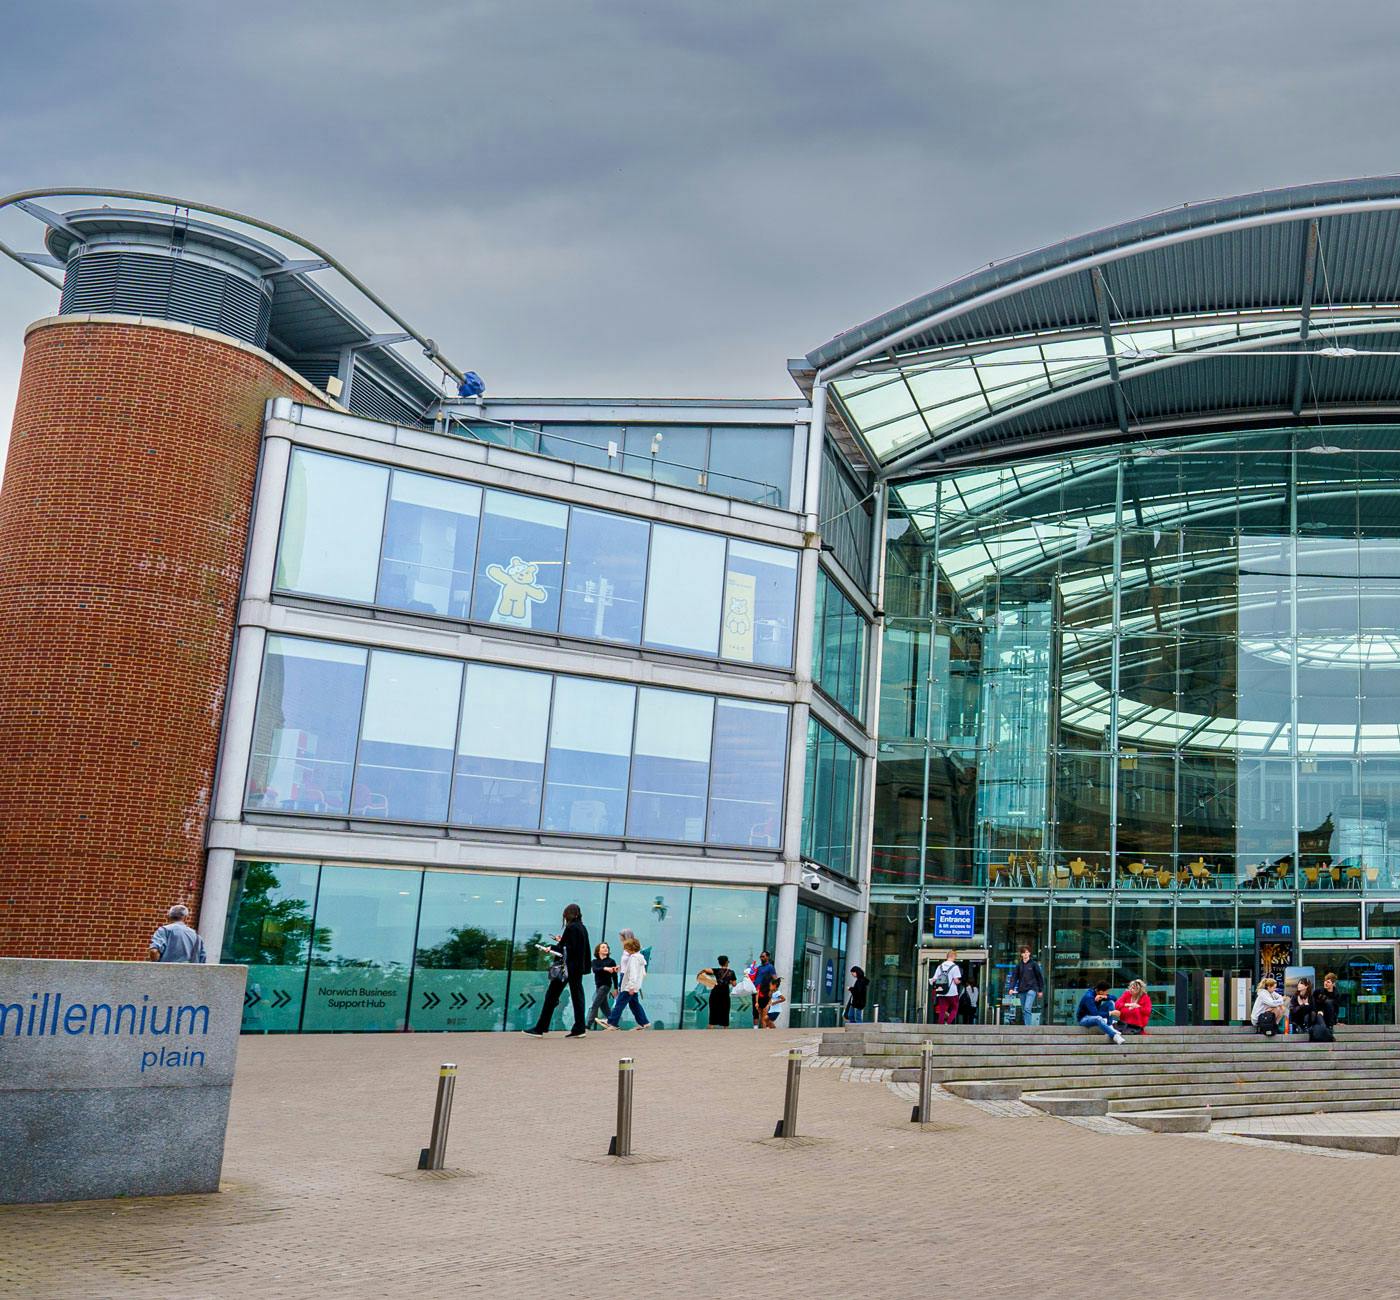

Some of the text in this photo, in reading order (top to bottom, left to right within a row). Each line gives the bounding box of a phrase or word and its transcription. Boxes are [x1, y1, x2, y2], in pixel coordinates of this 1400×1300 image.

[1261, 923, 1291, 935] form
[318, 987, 397, 997] Norwich Business
[328, 999, 386, 1009] Support Hub
[0, 993, 210, 1036] millennium
[141, 1047, 205, 1072] plain
